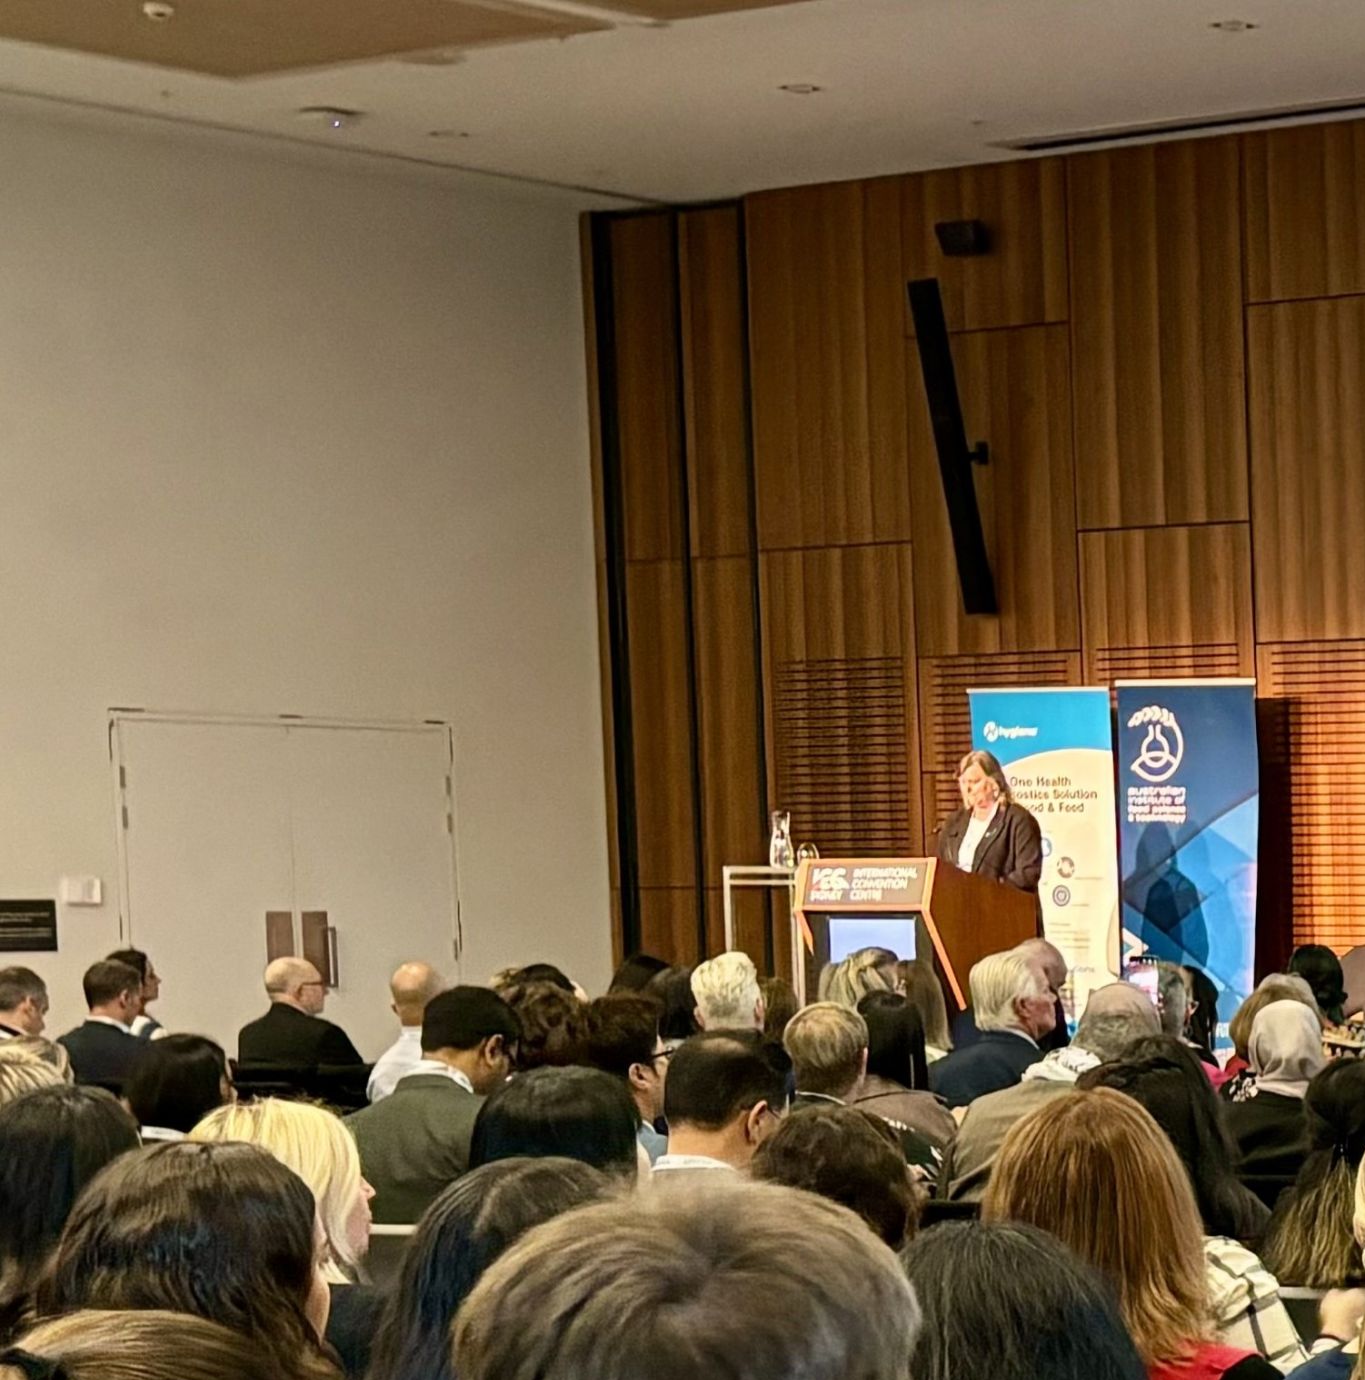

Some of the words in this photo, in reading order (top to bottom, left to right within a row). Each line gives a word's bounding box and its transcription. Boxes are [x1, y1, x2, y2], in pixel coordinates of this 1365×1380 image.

[1036, 776, 1071, 787] Health
[1053, 790, 1097, 799] Solution
[1059, 802, 1085, 812] Food
